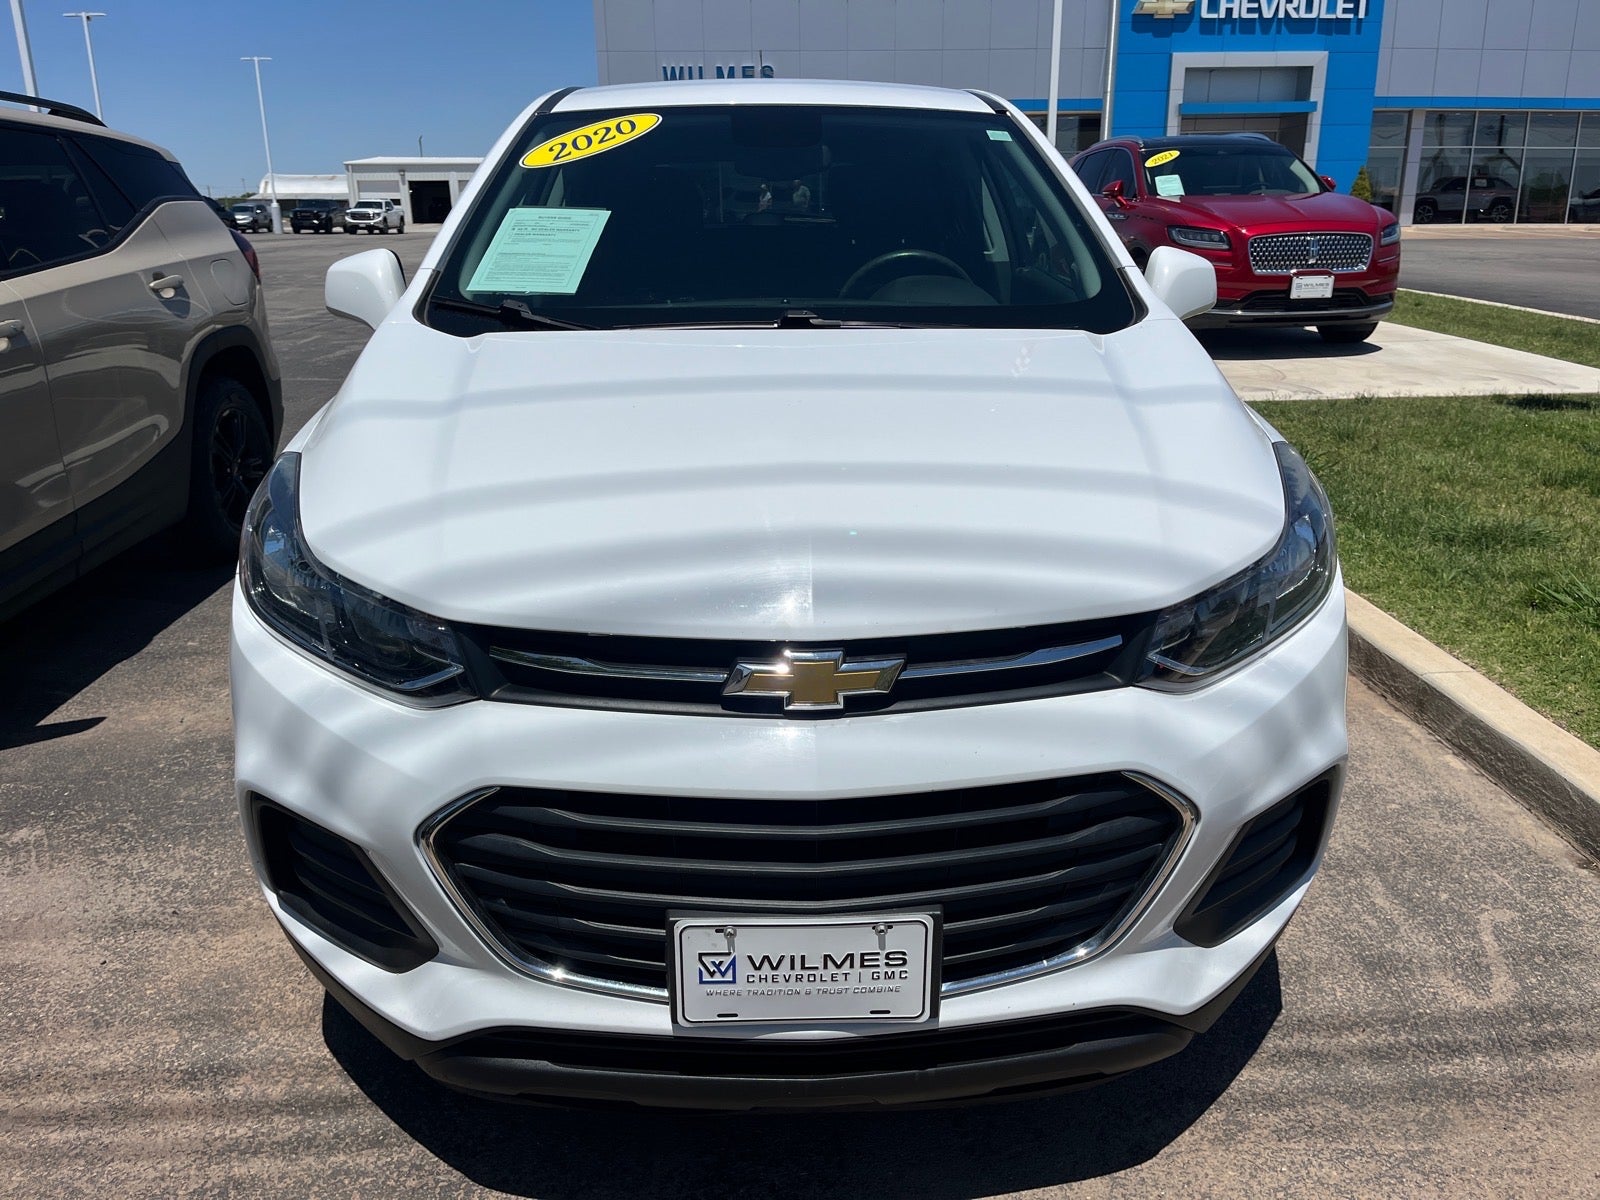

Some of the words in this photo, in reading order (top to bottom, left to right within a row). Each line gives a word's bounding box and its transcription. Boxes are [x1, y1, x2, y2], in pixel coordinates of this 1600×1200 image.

[548, 119, 637, 162] 2020
[1151, 152, 1173, 165] 2021
[746, 951, 908, 971] WILMES
[746, 972, 850, 984] CHEVROLET
[871, 970, 908, 981] GMC
[706, 989, 743, 997] WHERE
[746, 988, 801, 997] TRADITION
[816, 987, 850, 995] TRUST
[853, 985, 902, 995] COMBINE
